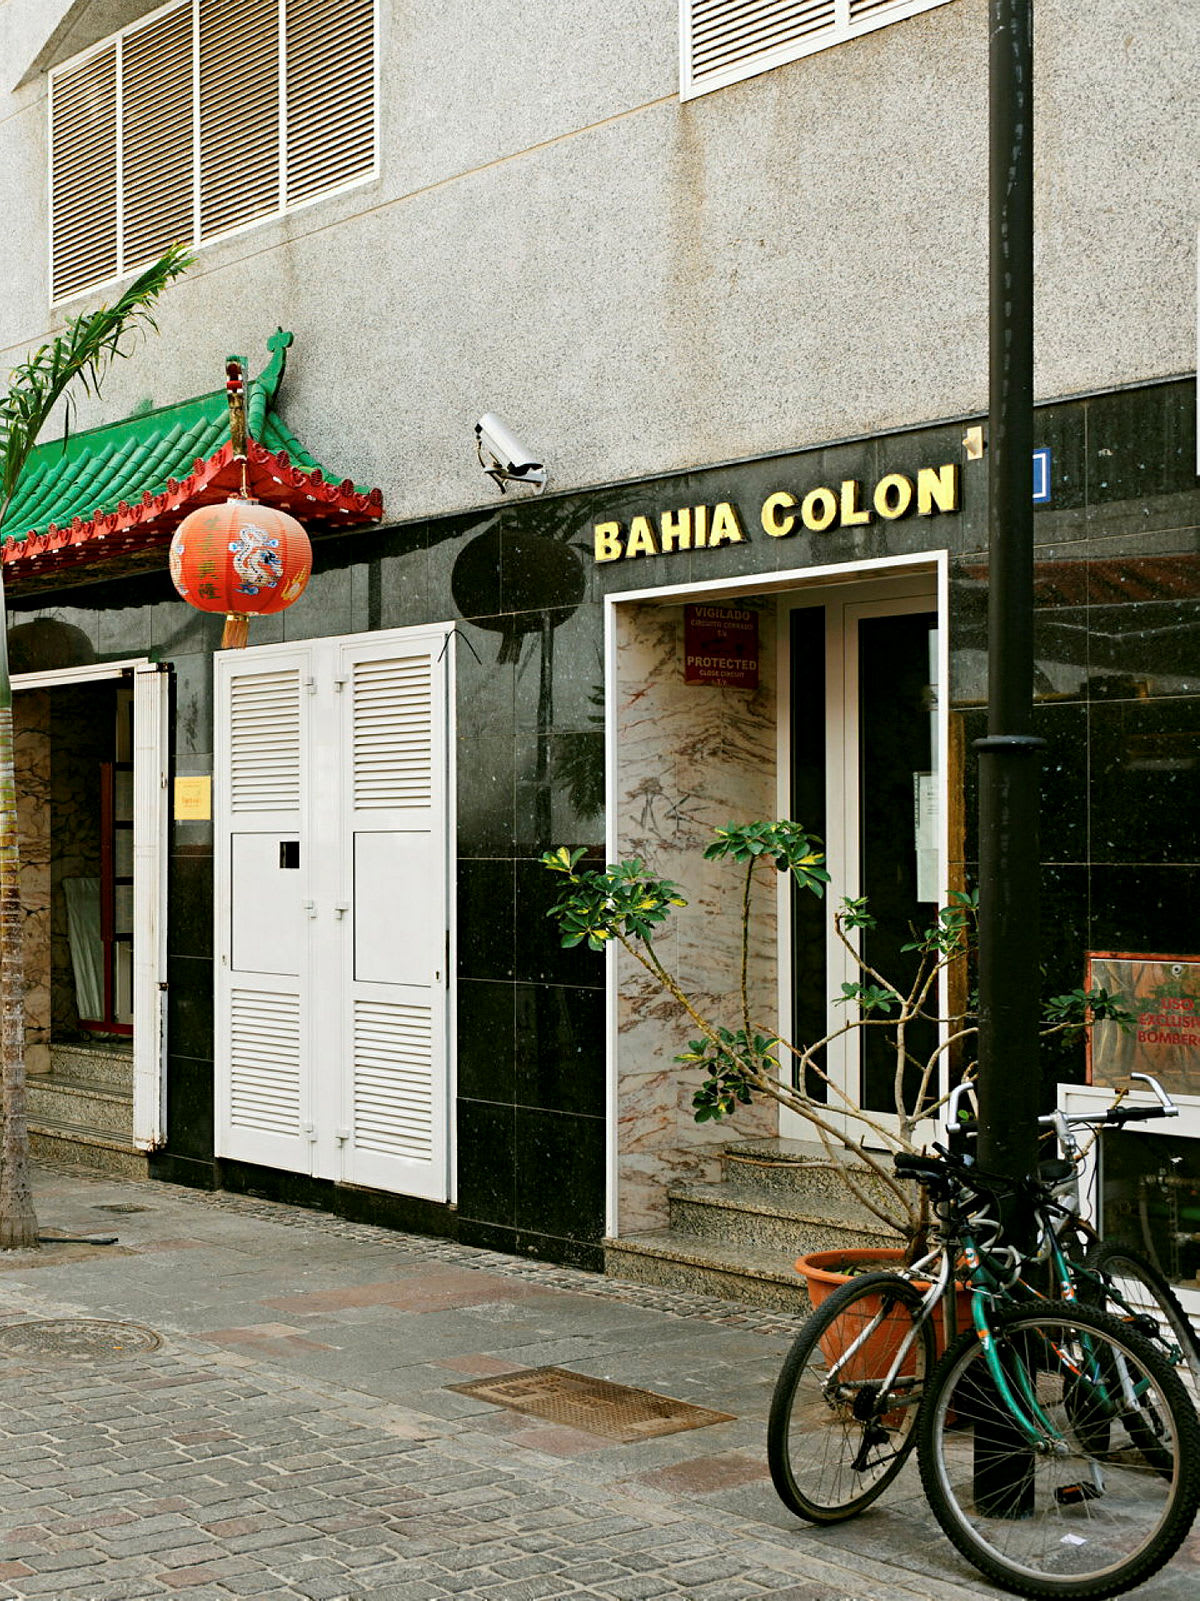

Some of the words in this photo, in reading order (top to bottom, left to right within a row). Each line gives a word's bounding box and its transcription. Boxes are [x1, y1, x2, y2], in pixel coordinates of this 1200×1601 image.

[593, 503, 745, 563] BAHIA
[761, 464, 959, 538] COLON
[695, 607, 751, 621] VIGILADO
[687, 656, 757, 670] PROTECTED
[1161, 997, 1195, 1011] USO
